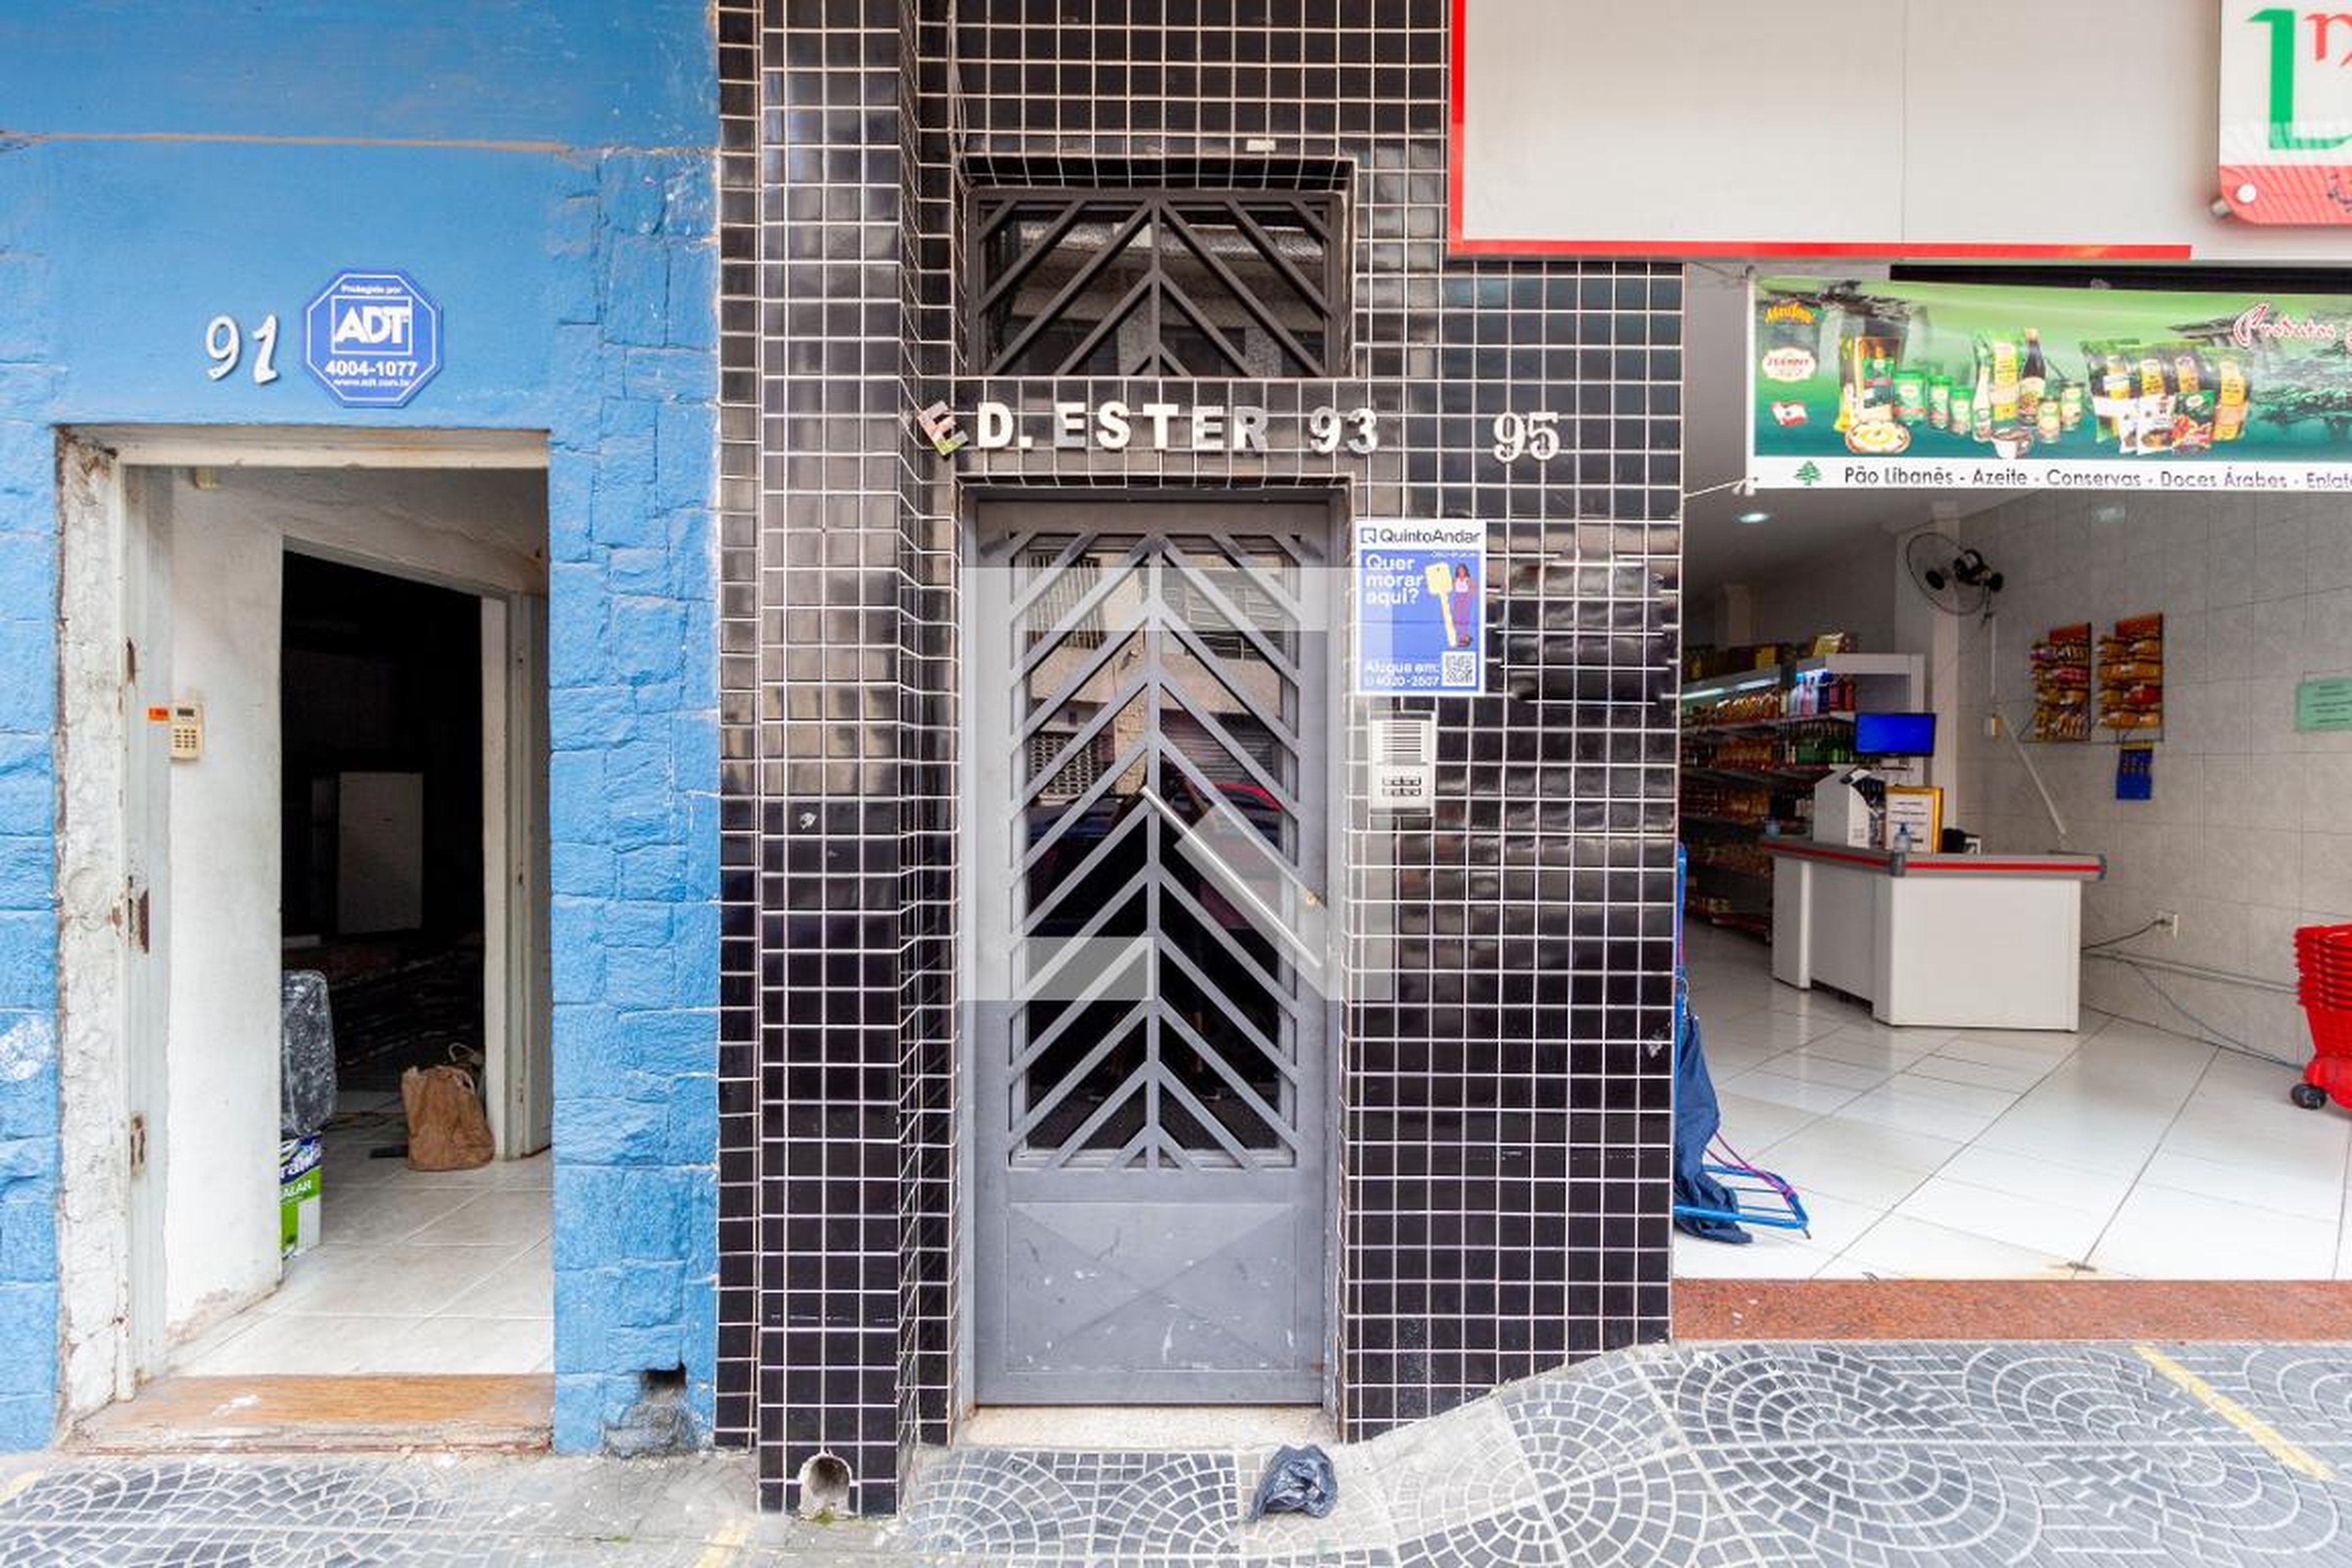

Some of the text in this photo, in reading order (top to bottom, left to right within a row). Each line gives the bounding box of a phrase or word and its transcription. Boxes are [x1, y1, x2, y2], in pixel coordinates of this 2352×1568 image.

[334, 306, 410, 344] ADT
[206, 315, 277, 383] 91
[325, 359, 417, 376] 4004-1077
[1054, 401, 1269, 452] ESTER
[1308, 405, 1378, 455] 93
[1493, 412, 1561, 462] 95
[1845, 466, 1879, 484] Pão
[1884, 467, 1953, 484] Libanês
[1972, 468, 2028, 485] Azeite
[2046, 469, 2141, 486] Conservas
[2161, 470, 2217, 488] Doces
[2225, 466, 2288, 488] Árabes
[2306, 472, 2352, 489] Enlat
[1380, 529, 1480, 543] QuintoAndar
[1366, 555, 1415, 571] Quer
[1366, 574, 1424, 587] morar
[1366, 588, 1419, 606] aqui?
